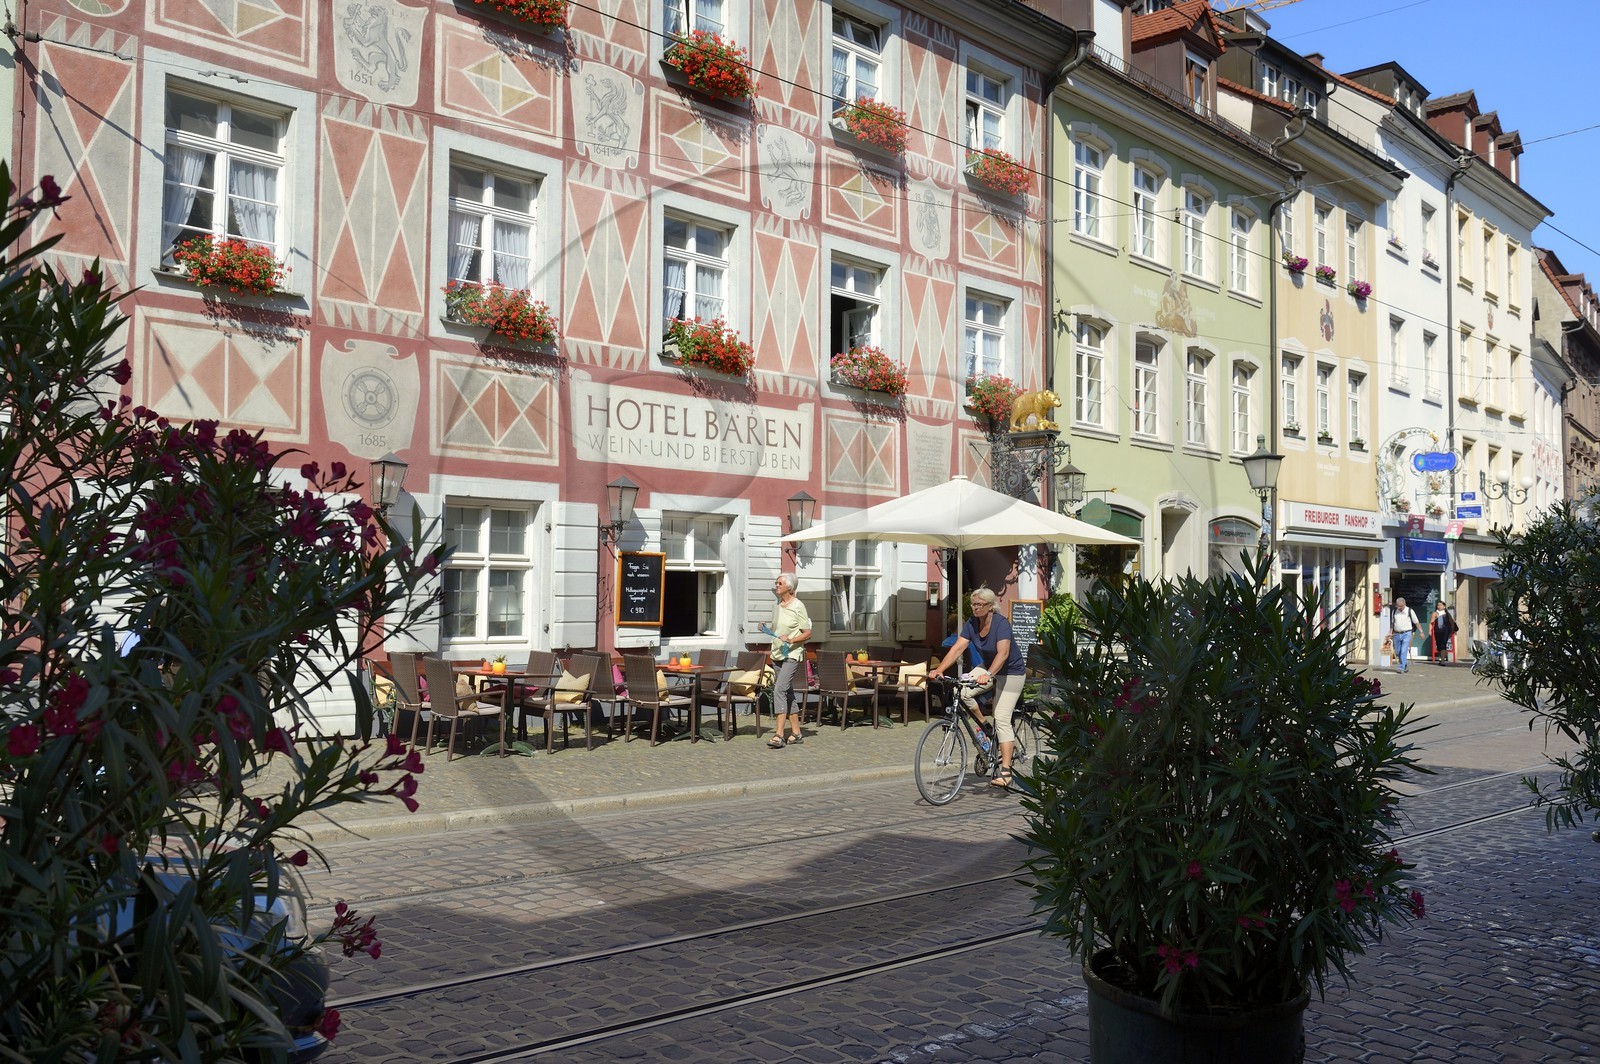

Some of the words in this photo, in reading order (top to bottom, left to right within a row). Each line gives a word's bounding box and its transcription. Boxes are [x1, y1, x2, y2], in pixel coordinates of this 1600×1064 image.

[349, 70, 373, 86] 1651
[592, 144, 610, 157] 1641
[587, 394, 697, 438] HOTEL
[705, 410, 802, 452] BÄREN
[357, 433, 386, 447] 1685
[703, 445, 801, 471] BIERSTUBEN
[1304, 509, 1340, 526] FREIBURGER
[1344, 514, 1368, 528] FANSHOP
